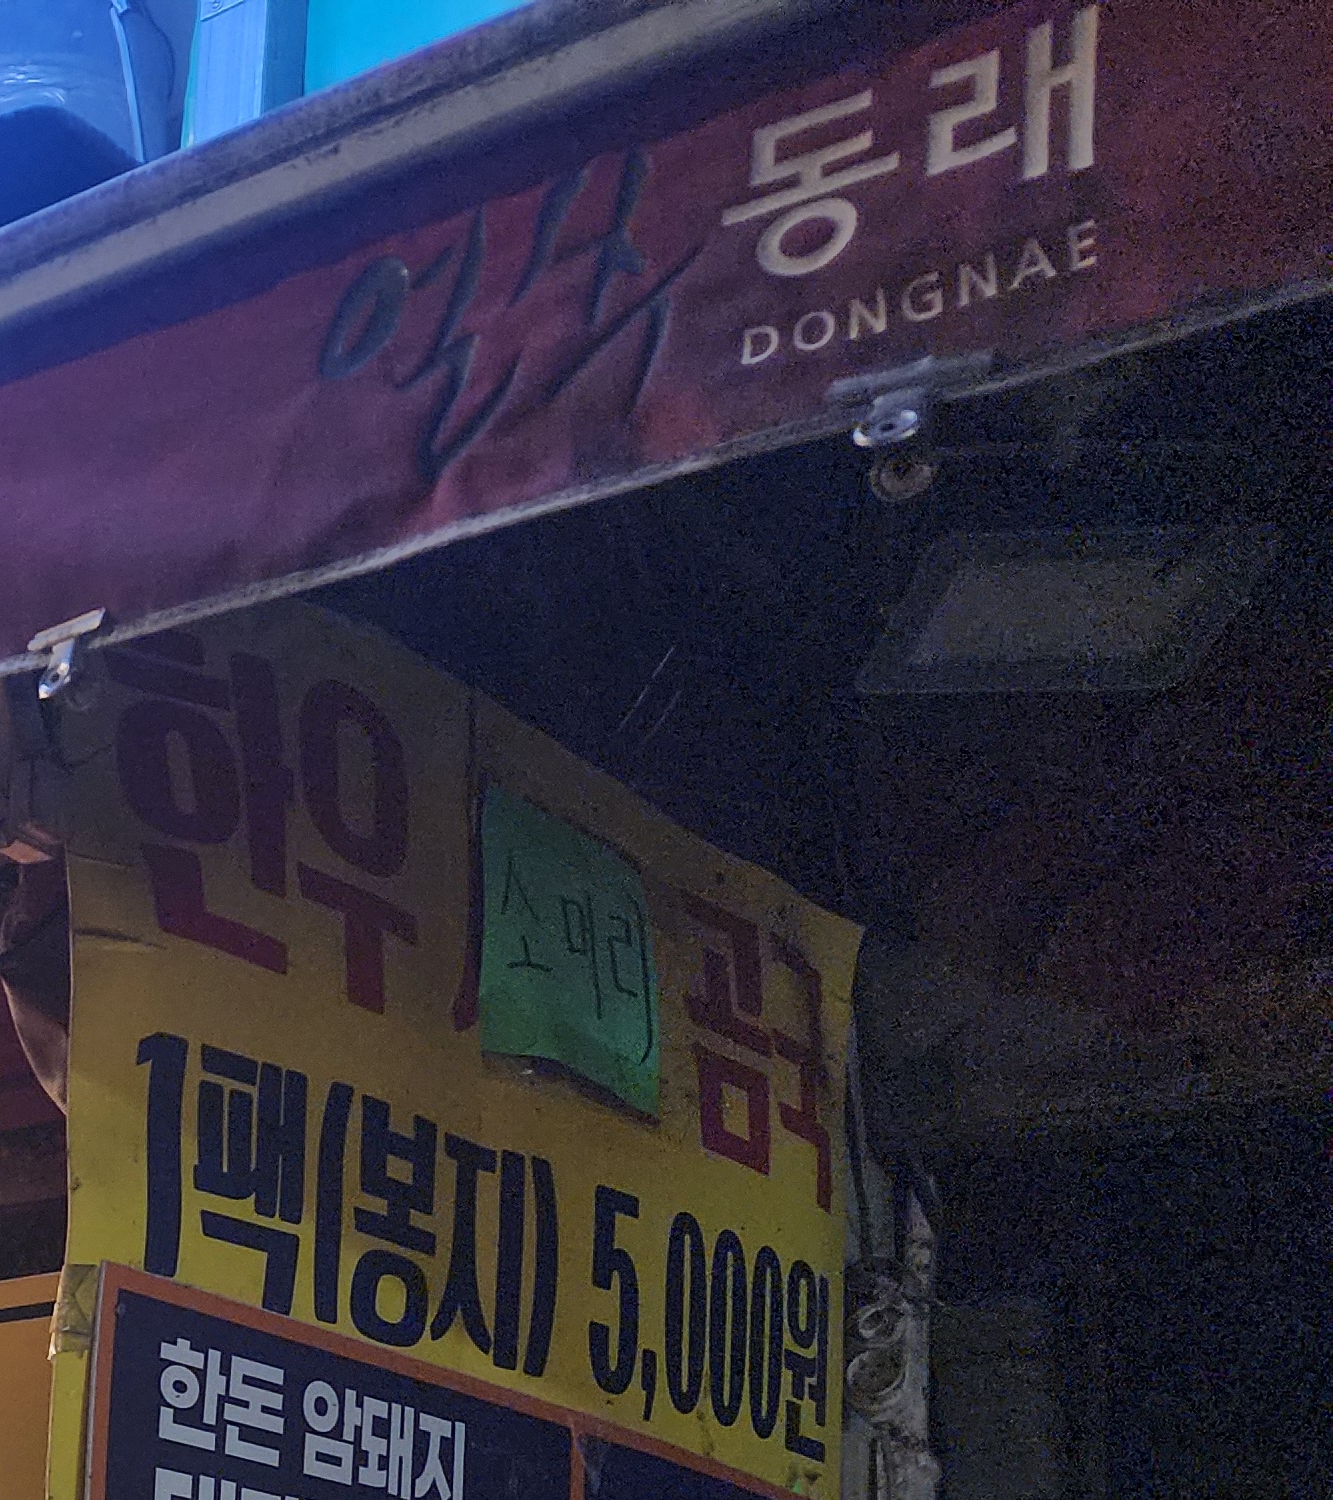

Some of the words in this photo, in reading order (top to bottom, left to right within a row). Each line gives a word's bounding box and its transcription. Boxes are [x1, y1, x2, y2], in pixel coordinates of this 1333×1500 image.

[721, 4, 1099, 277] 동래
[740, 220, 1099, 366] DONGNAE
[104, 632, 419, 1014] 한우
[159, 1337, 285, 1467] 한돈
[588, 1184, 830, 1463] 5,000원
